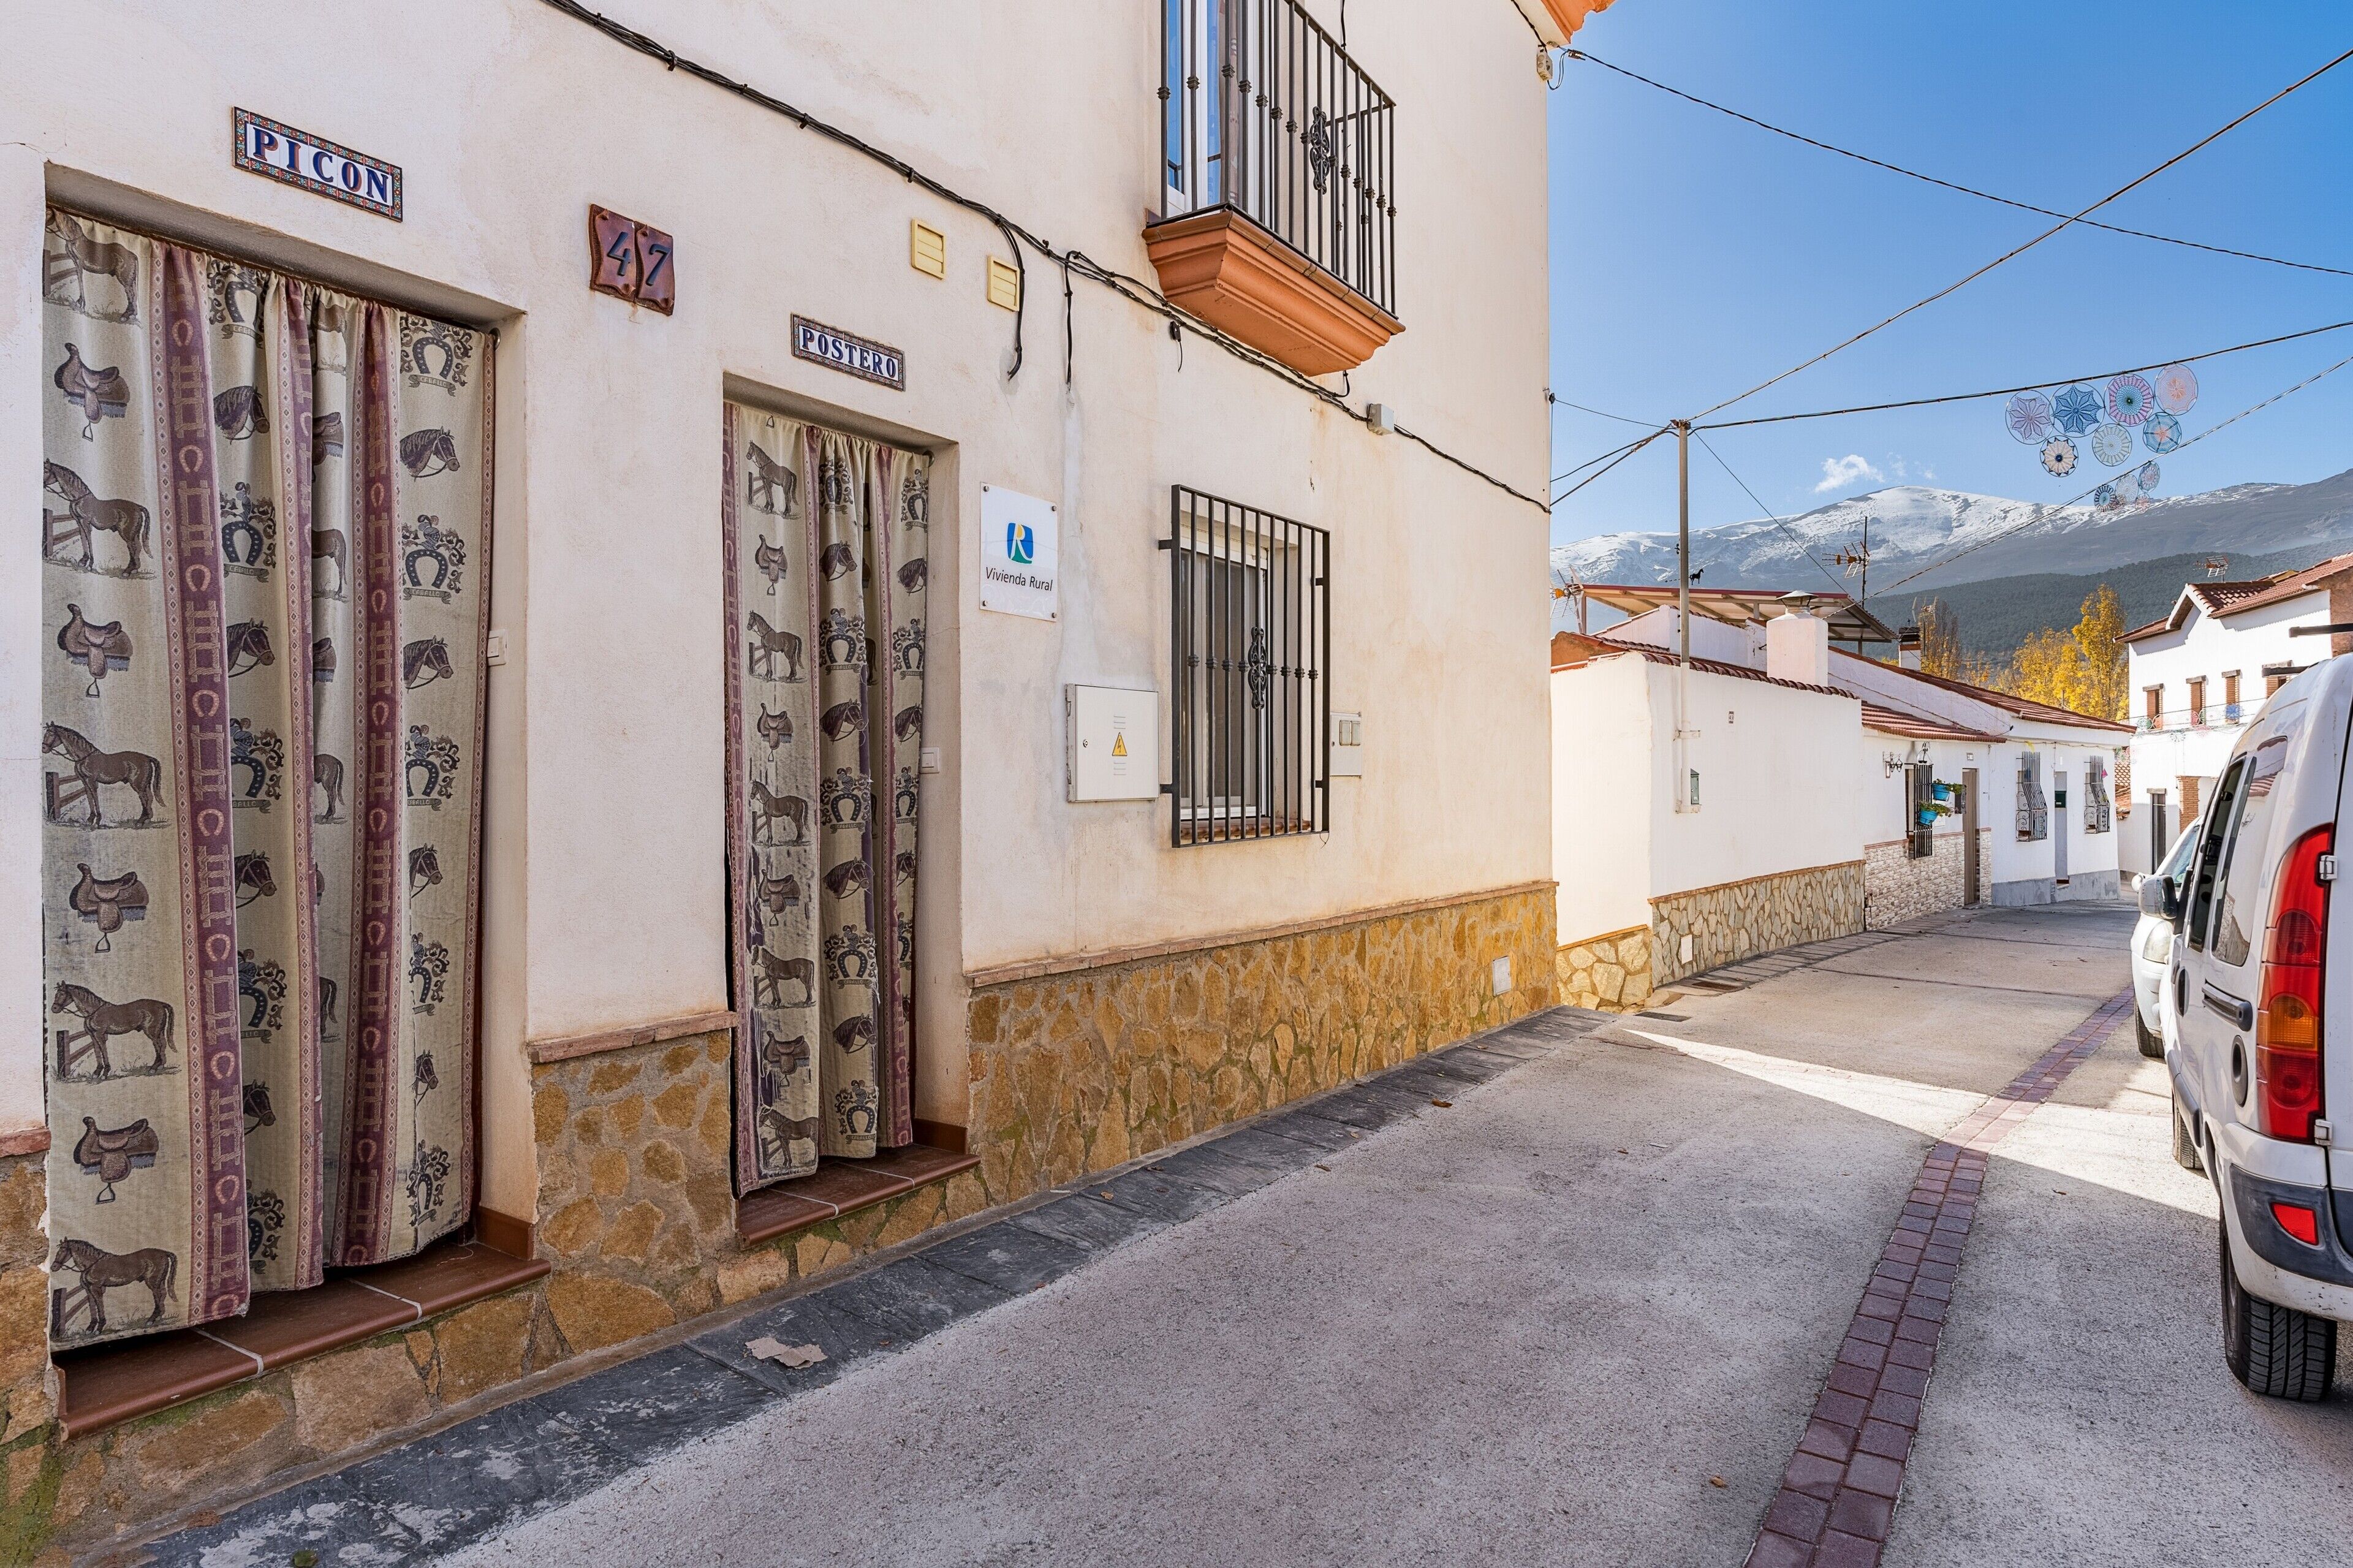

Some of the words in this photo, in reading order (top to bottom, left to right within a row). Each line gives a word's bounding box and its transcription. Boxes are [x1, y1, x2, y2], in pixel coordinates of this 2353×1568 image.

[253, 126, 389, 203] PICON
[607, 231, 672, 287] 47
[801, 328, 896, 379] POSTERO
[986, 566, 1026, 586] Vivienda
[1029, 575, 1053, 591] Rural
